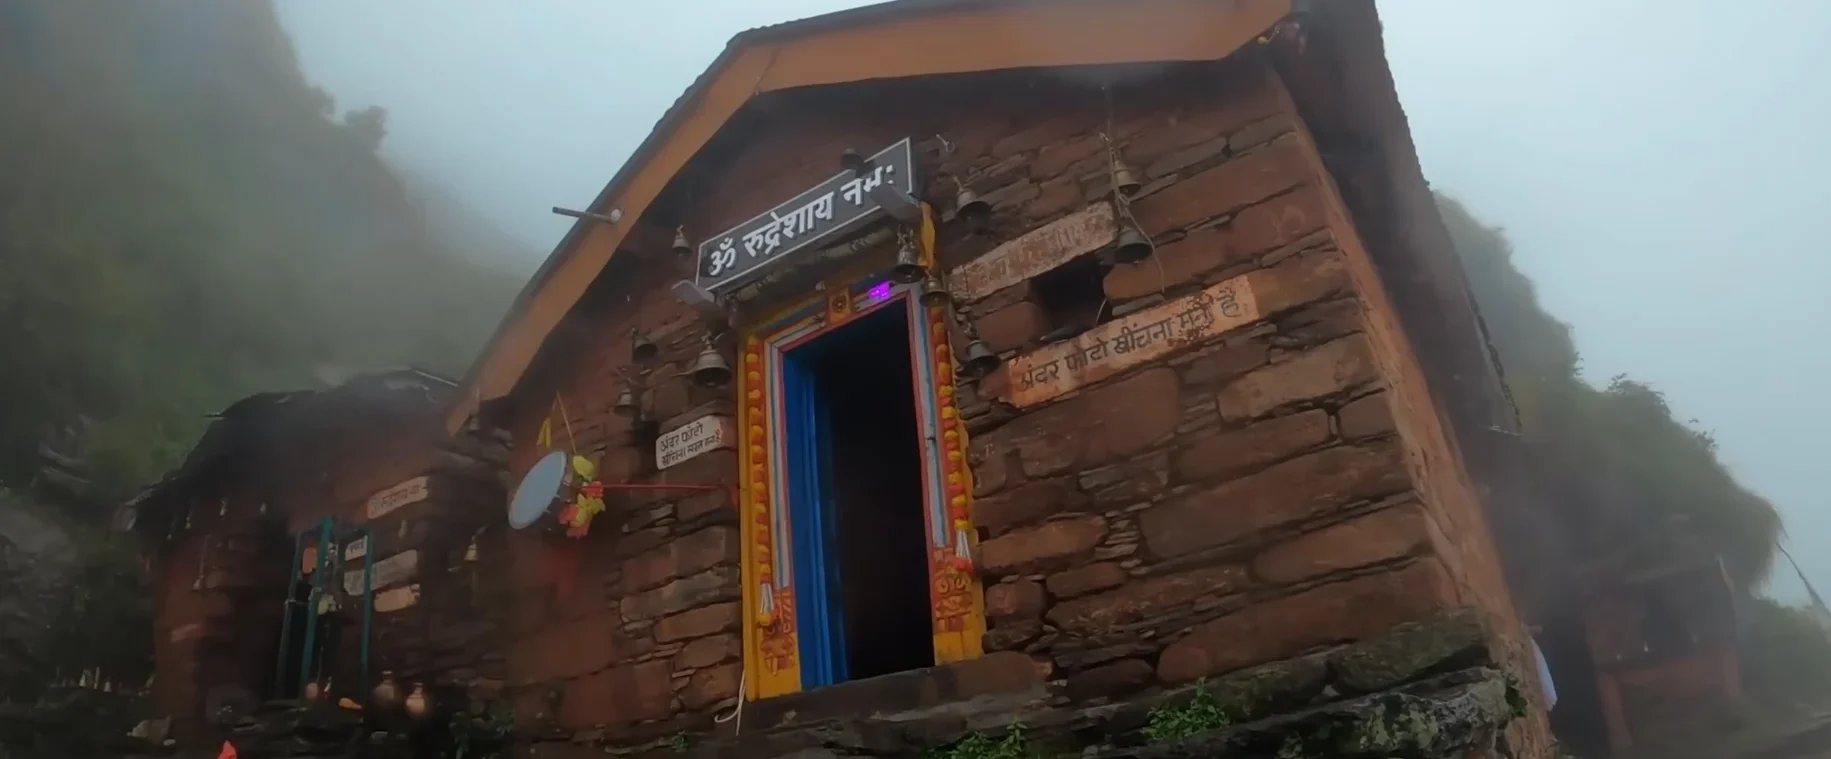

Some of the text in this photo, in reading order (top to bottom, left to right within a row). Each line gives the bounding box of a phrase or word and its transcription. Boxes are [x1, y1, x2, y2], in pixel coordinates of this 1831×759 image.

[709, 164, 894, 276] ॐ रुद्रेशाय नमः
[1020, 359, 1059, 392] अंदर
